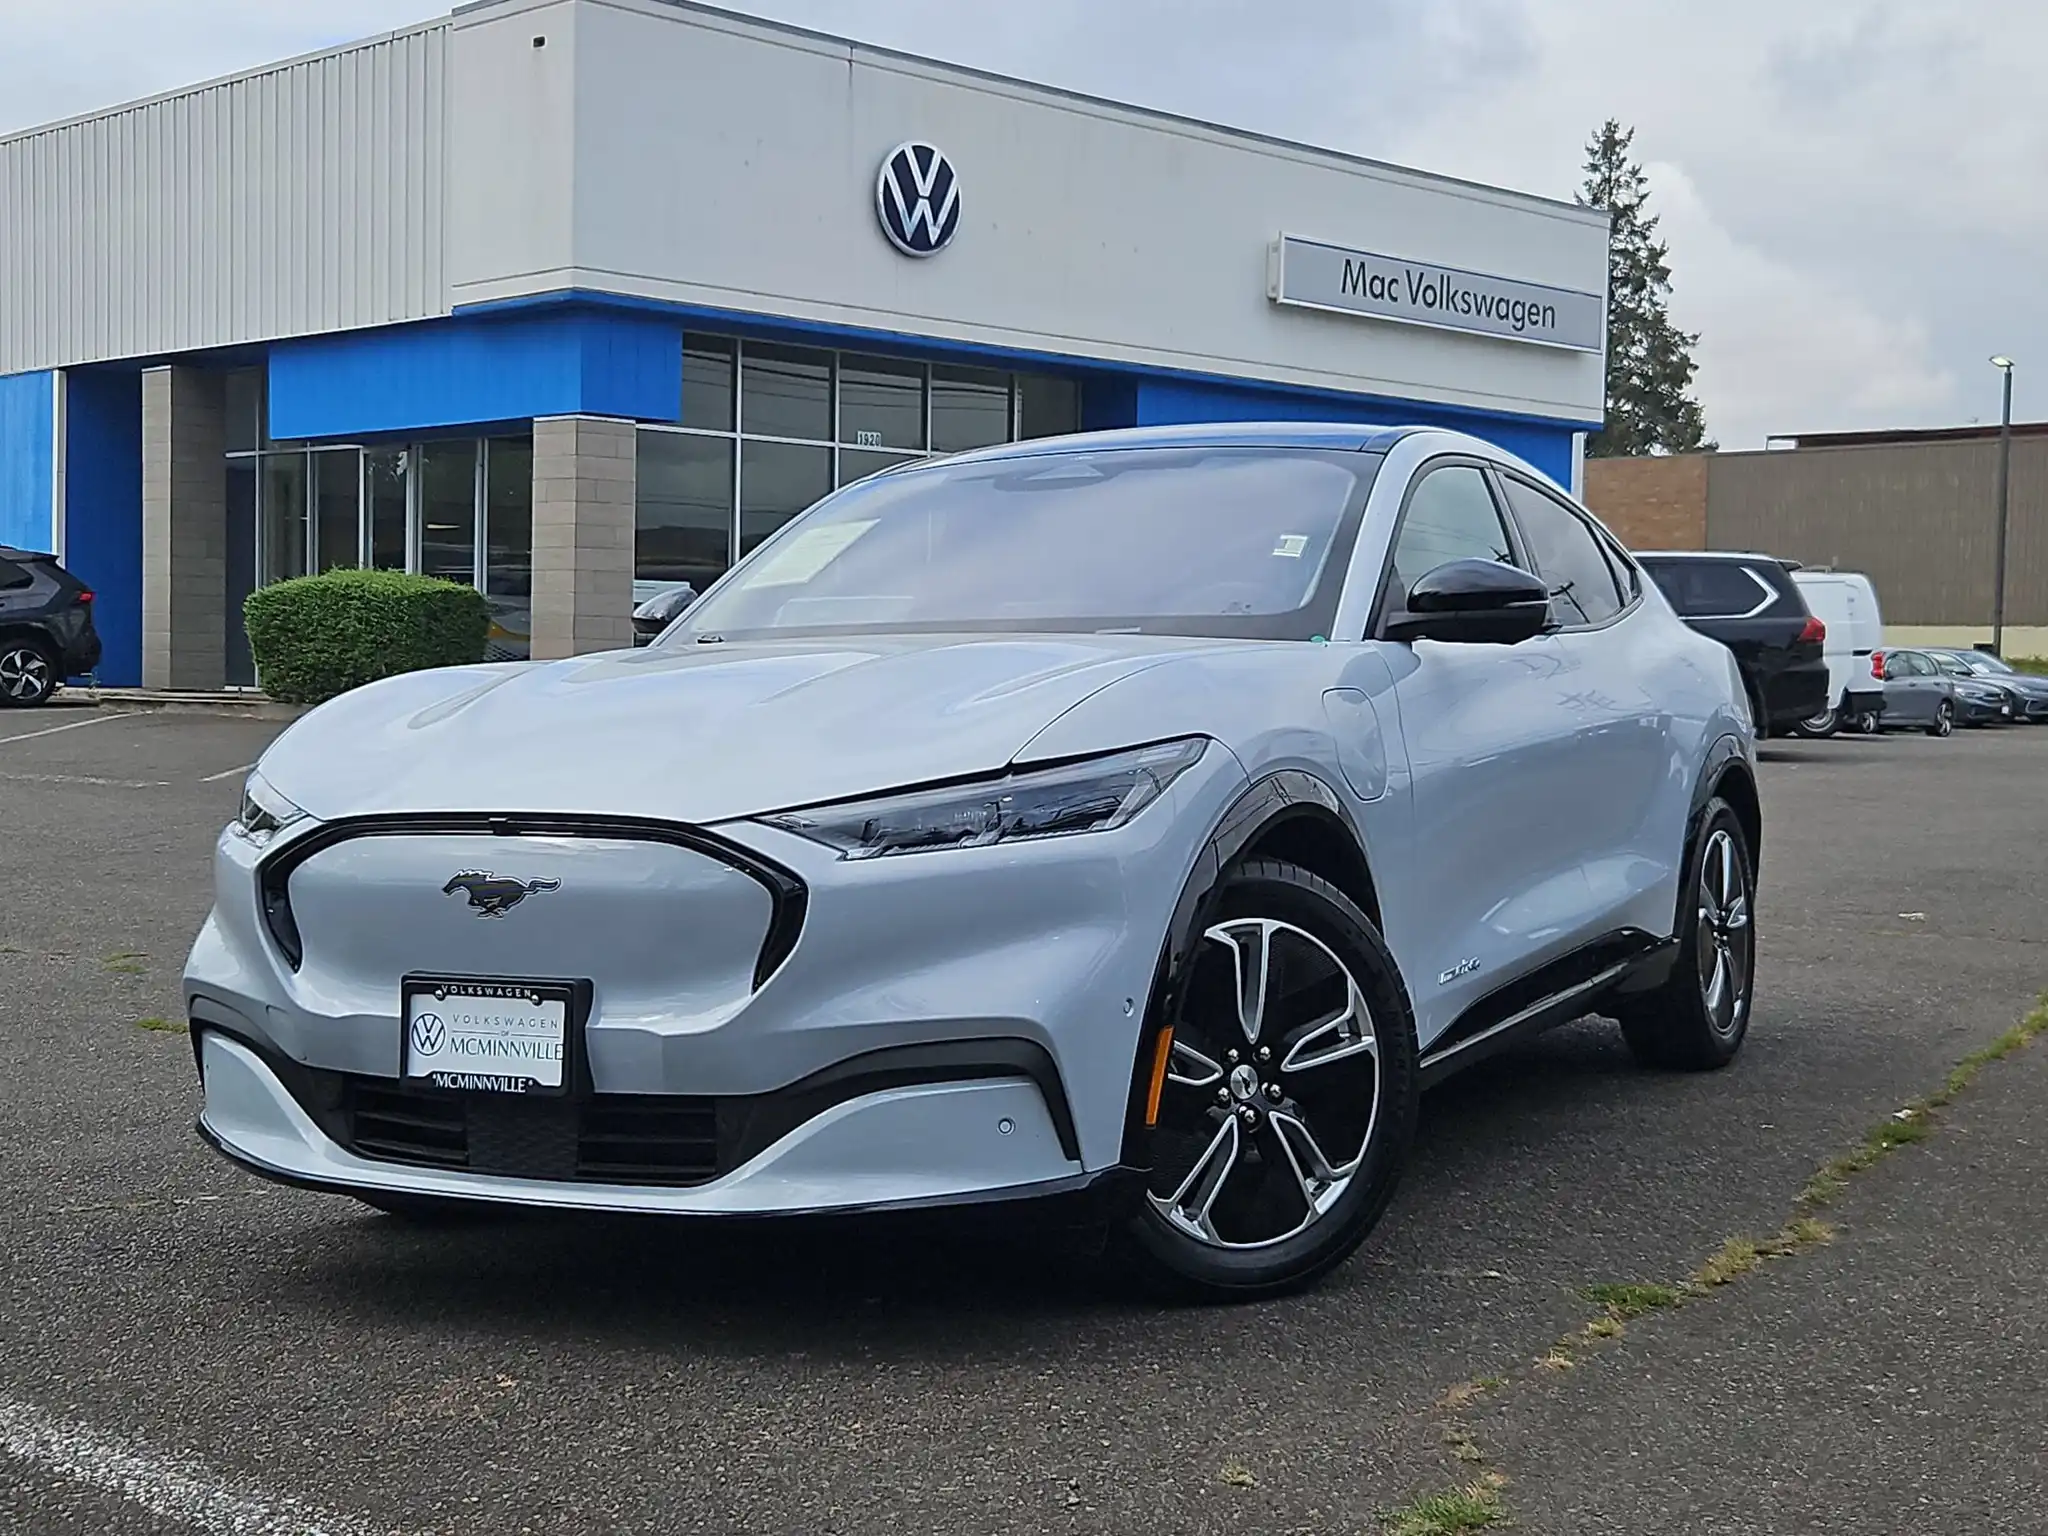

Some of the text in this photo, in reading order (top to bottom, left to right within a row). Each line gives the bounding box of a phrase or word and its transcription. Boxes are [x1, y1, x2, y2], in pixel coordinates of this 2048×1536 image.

[1341, 258, 1555, 331] Mac Volkswagen
[859, 432, 881, 446] 1920
[441, 984, 531, 998] VOLKSWAGEN
[452, 1013, 558, 1029] VOLKSWAGEN
[450, 1037, 563, 1060] MCMINNVILLE
[435, 1073, 526, 1093] MCMINNVILLE
